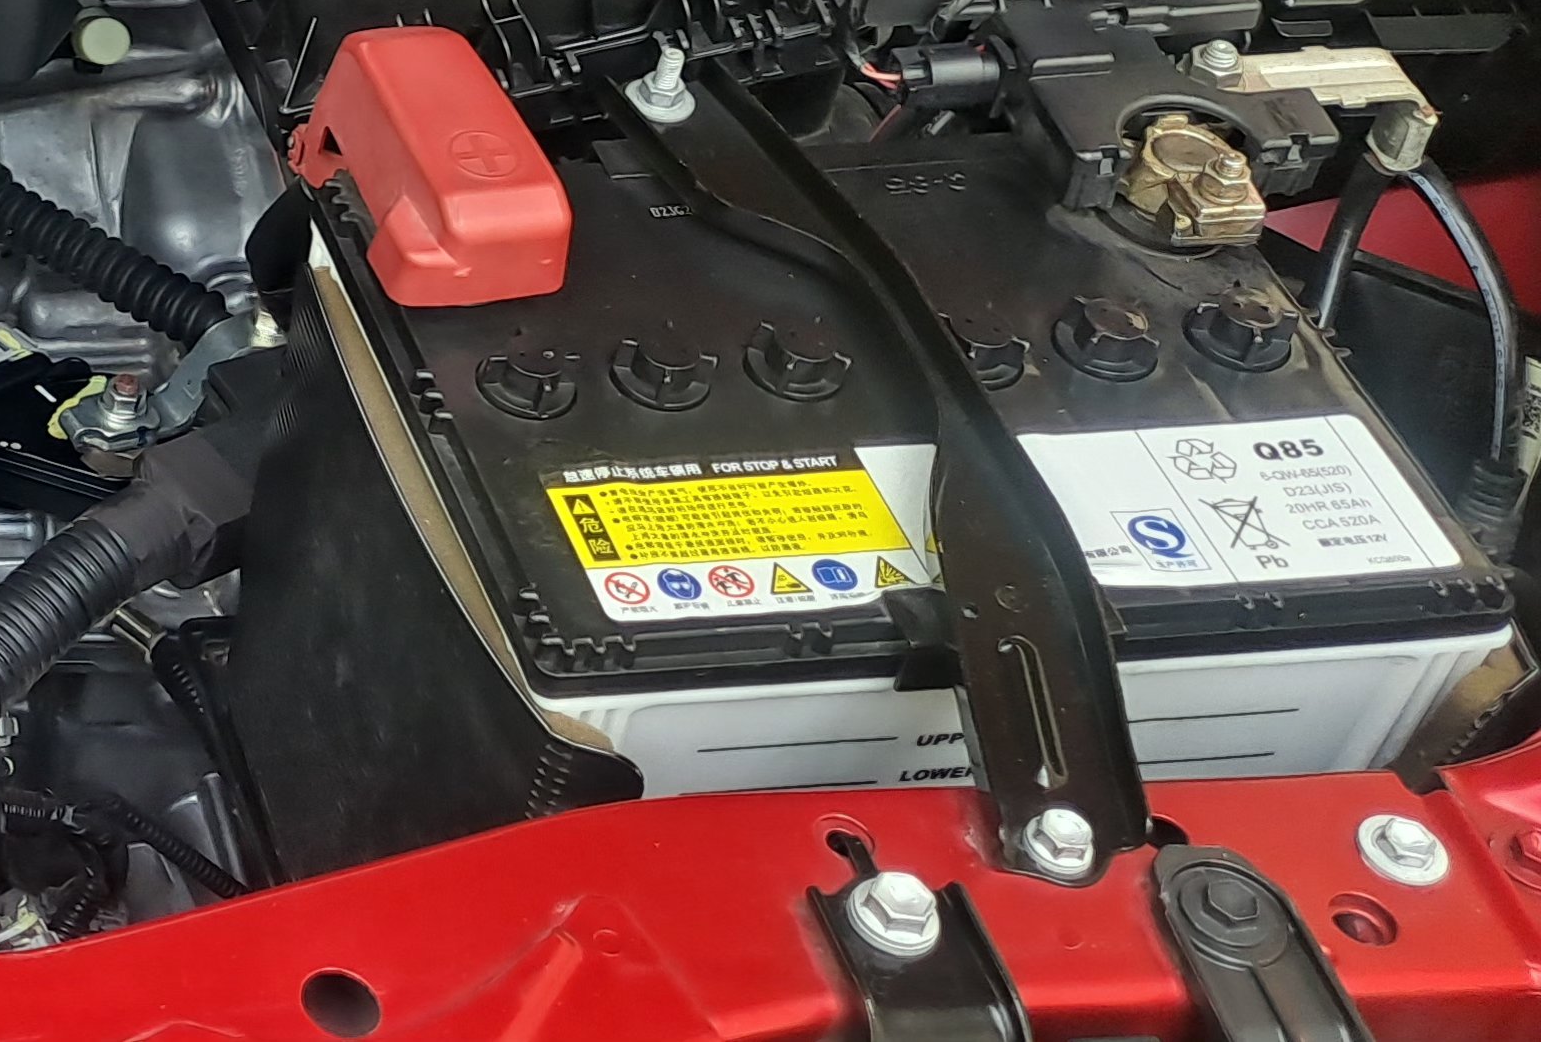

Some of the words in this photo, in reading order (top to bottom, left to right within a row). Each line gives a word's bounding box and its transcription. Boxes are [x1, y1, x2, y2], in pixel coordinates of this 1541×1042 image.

[1253, 439, 1324, 461] Q85
[711, 462, 743, 474] FOR
[742, 459, 779, 472] STOP
[781, 459, 793, 470] &
[793, 455, 837, 469] START
[1282, 482, 1352, 497] D23(JIS)
[1285, 500, 1330, 514] 20HR
[1302, 518, 1339, 530] CCA
[1339, 514, 1381, 528] 520A
[579, 517, 614, 555] 危险
[1256, 554, 1289, 570] Pb
[917, 732, 965, 746] UPP
